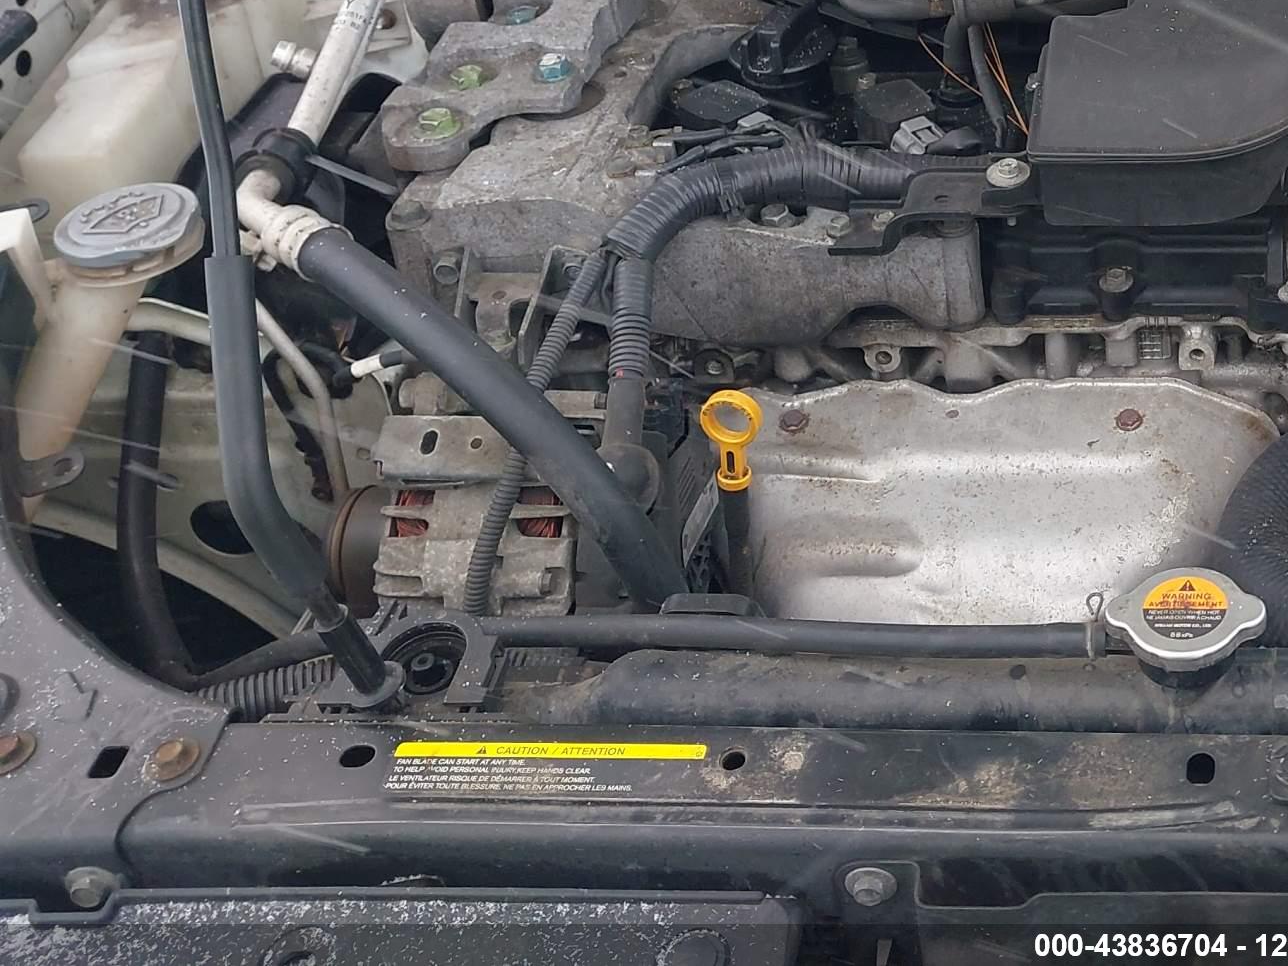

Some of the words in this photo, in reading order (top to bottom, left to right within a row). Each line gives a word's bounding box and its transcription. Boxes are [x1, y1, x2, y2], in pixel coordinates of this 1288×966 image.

[496, 746, 549, 755] CAUTION
[561, 746, 626, 756] ATTENTION
[490, 774, 533, 783] DÉMARRER
[561, 776, 596, 784] MOMENT.
[385, 782, 408, 790] POUR
[408, 781, 434, 790] ÉVITER
[543, 784, 592, 792] APPROCHER
[607, 784, 633, 792] MAINS.
